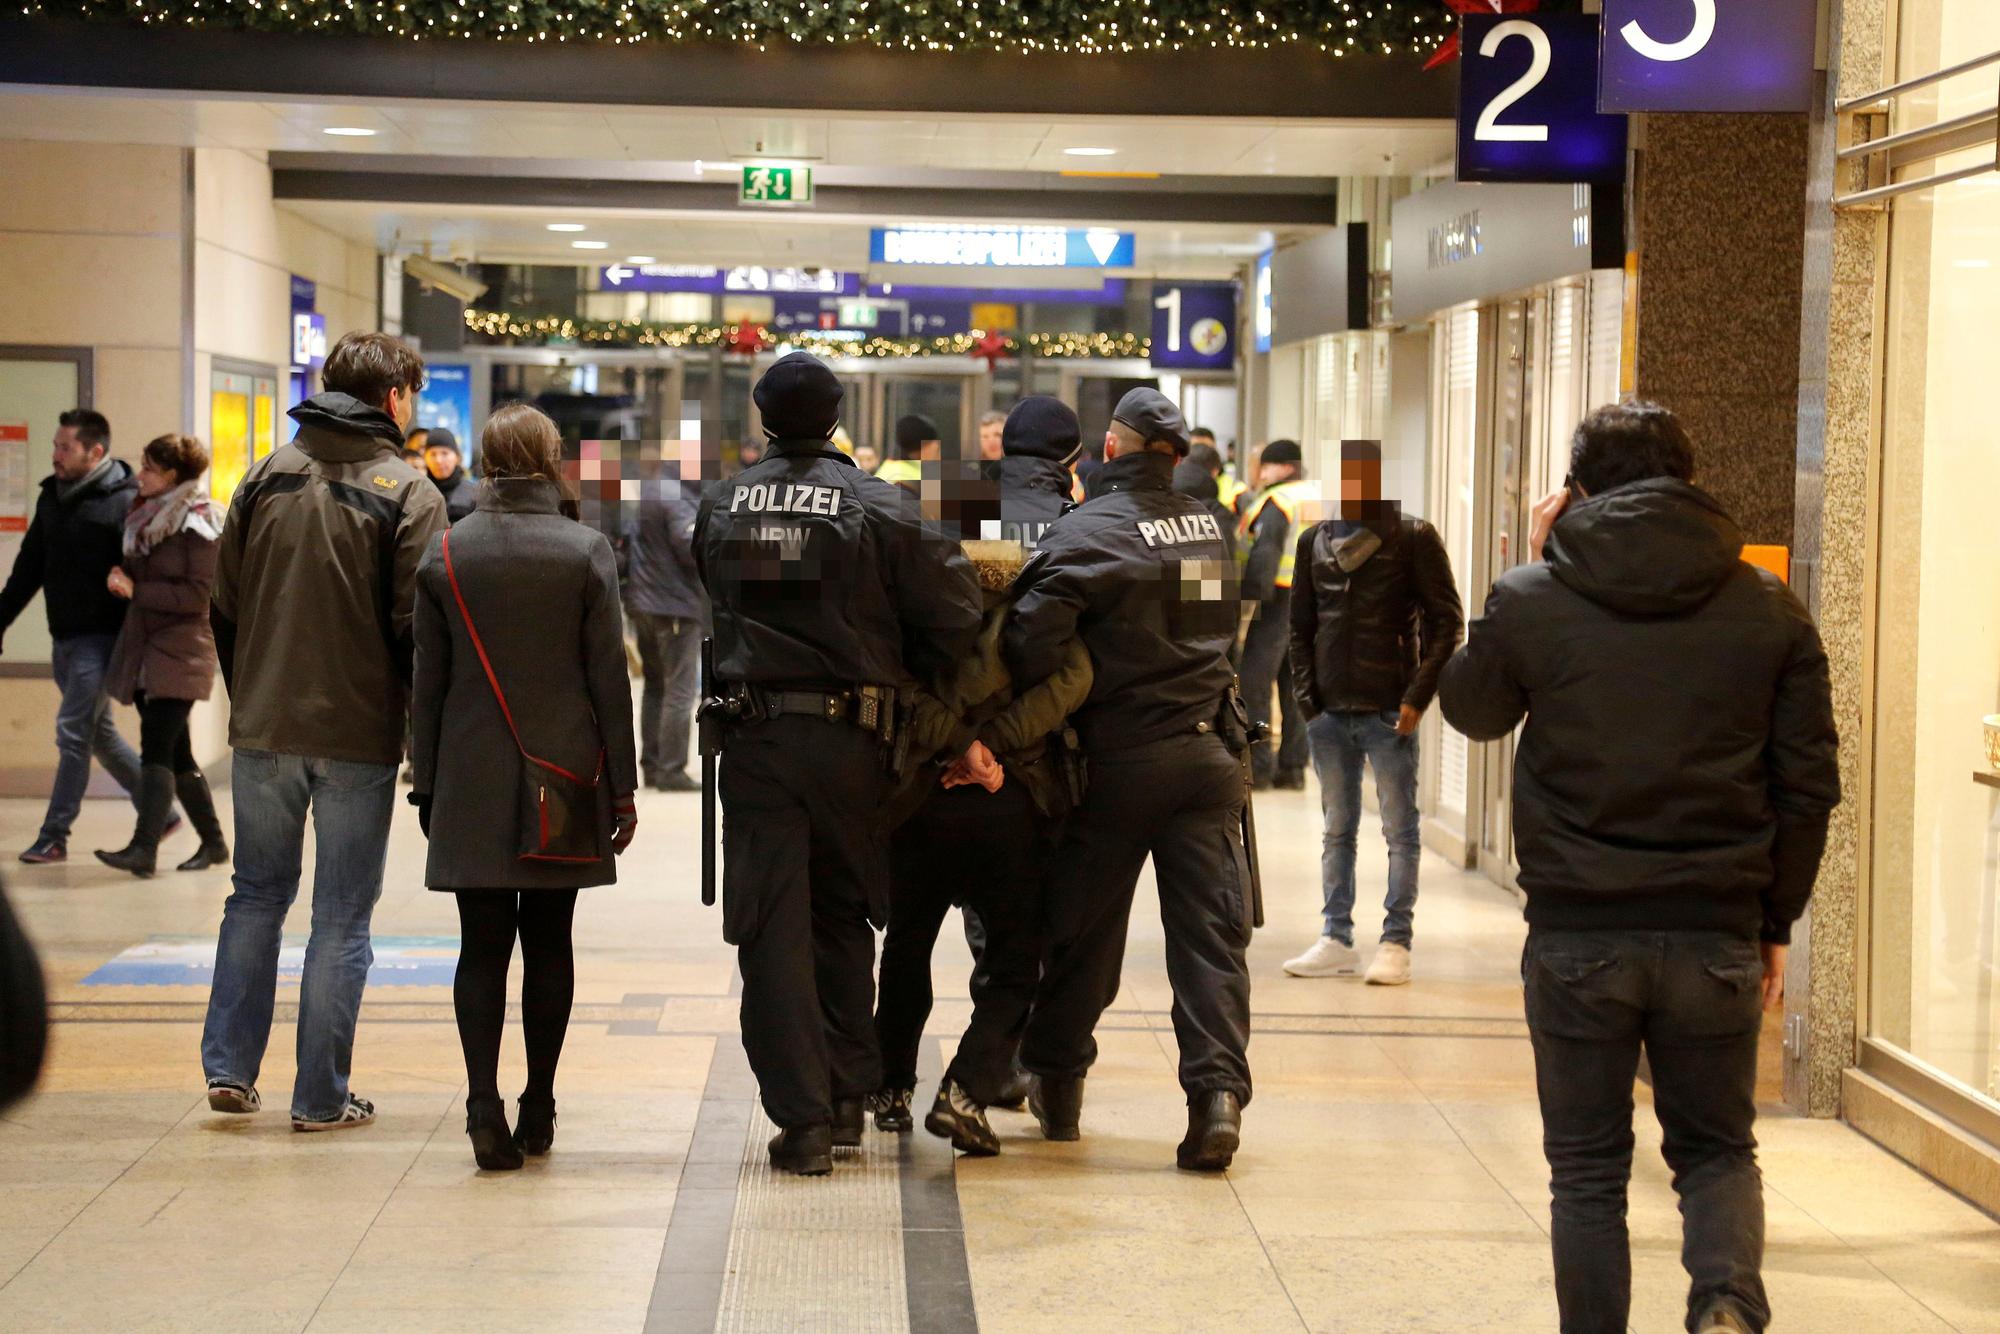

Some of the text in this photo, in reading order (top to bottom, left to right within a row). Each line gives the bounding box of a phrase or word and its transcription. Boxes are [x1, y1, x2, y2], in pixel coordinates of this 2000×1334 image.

[1474, 19, 1551, 141] 2
[1155, 288, 1181, 351] 1
[730, 484, 841, 516] POLIZEI
[1137, 514, 1223, 547] POLIZEI
